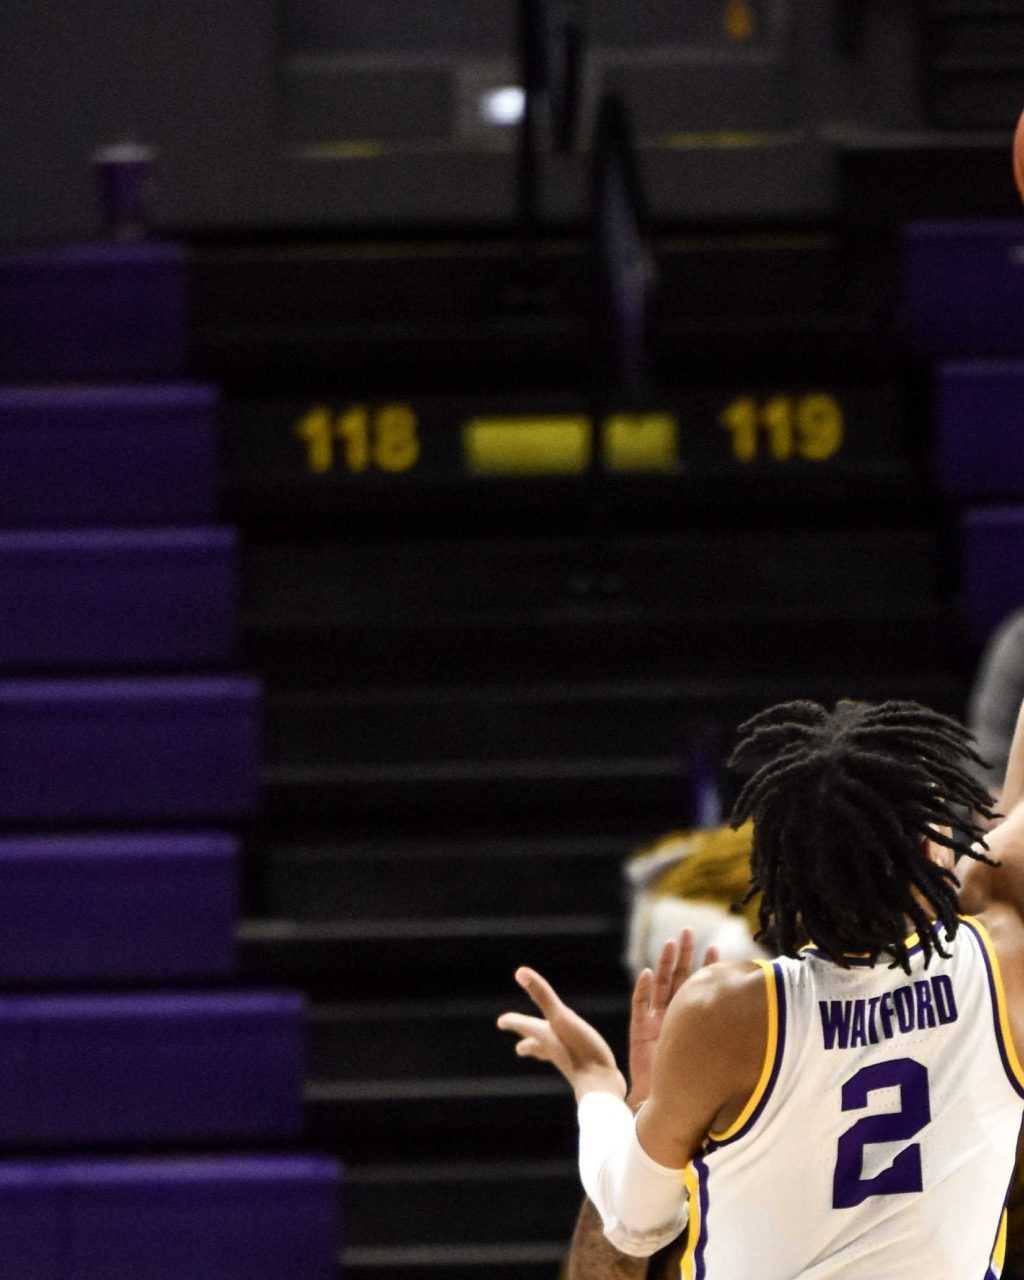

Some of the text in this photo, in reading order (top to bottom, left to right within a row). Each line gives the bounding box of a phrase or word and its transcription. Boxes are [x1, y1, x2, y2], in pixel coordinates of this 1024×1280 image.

[296, 405, 419, 472] 118
[722, 393, 843, 462] 119
[819, 975, 958, 1050] WATFORD
[832, 1057, 931, 1209] 2
